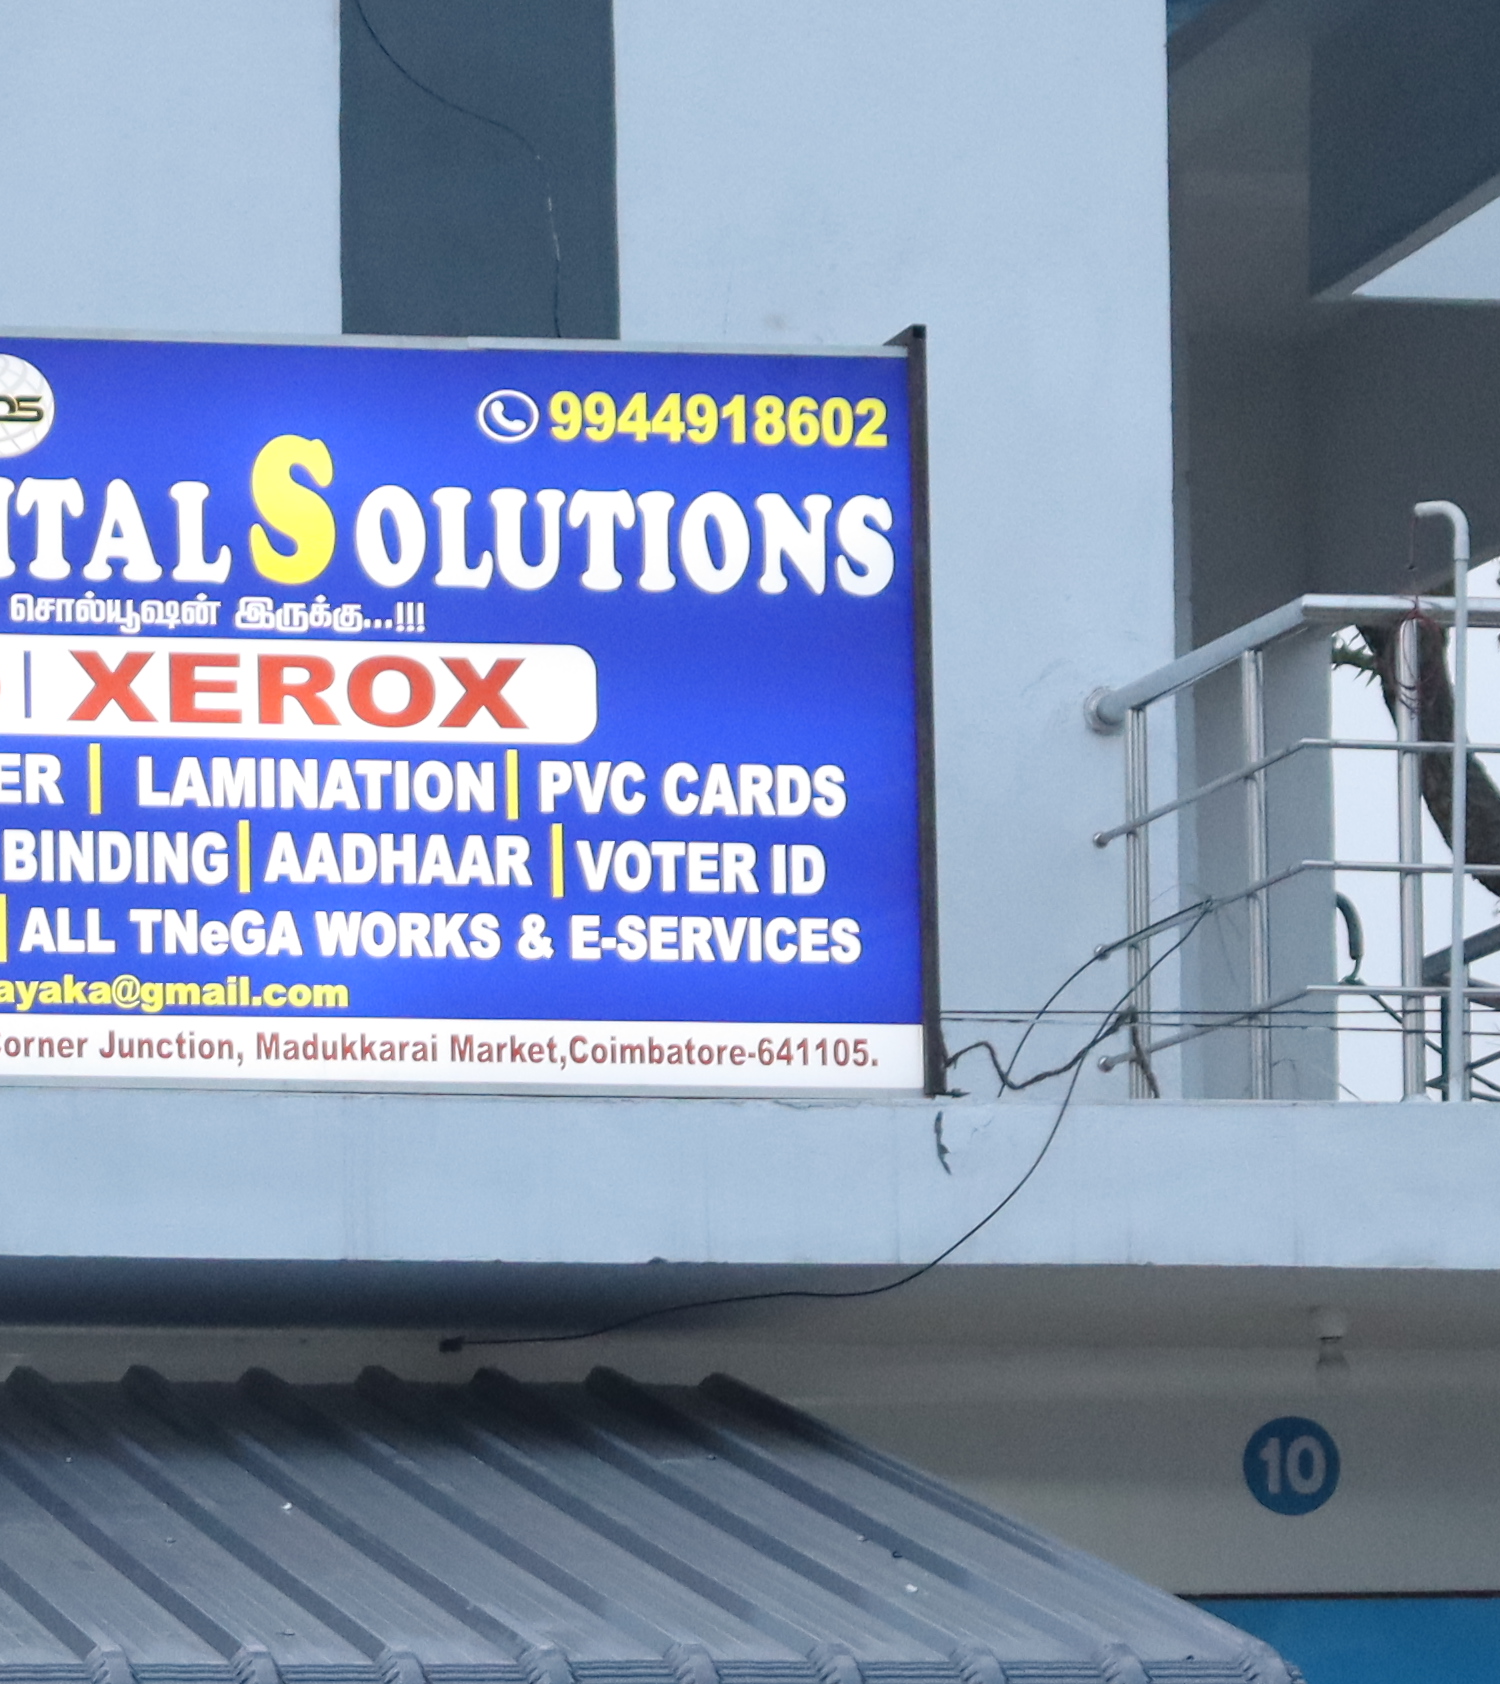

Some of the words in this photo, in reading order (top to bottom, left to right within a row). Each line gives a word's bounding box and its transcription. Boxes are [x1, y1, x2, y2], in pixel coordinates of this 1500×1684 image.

[549, 391, 887, 448] 9944918602
[250, 433, 894, 597] SOLUTIONS
[10, 588, 221, 633] சொல்யூஷன்
[69, 651, 526, 728] XEROX
[137, 756, 494, 812] LAMINATION
[539, 761, 645, 815] PVC
[662, 762, 846, 818] CARDS
[3, 829, 228, 886] BINDING
[264, 832, 532, 886] AADHAAR
[576, 841, 759, 894] VOTER
[771, 845, 825, 895] ID
[19, 907, 115, 954] ALL
[129, 909, 303, 956] TNeGA
[314, 911, 500, 960] WORKS
[517, 914, 554, 960] &
[570, 915, 861, 964] E-SERVICES
[100, 1031, 242, 1066] Junction,
[257, 1033, 437, 1061] Madukkarai
[1260, 1436, 1325, 1494] 10
